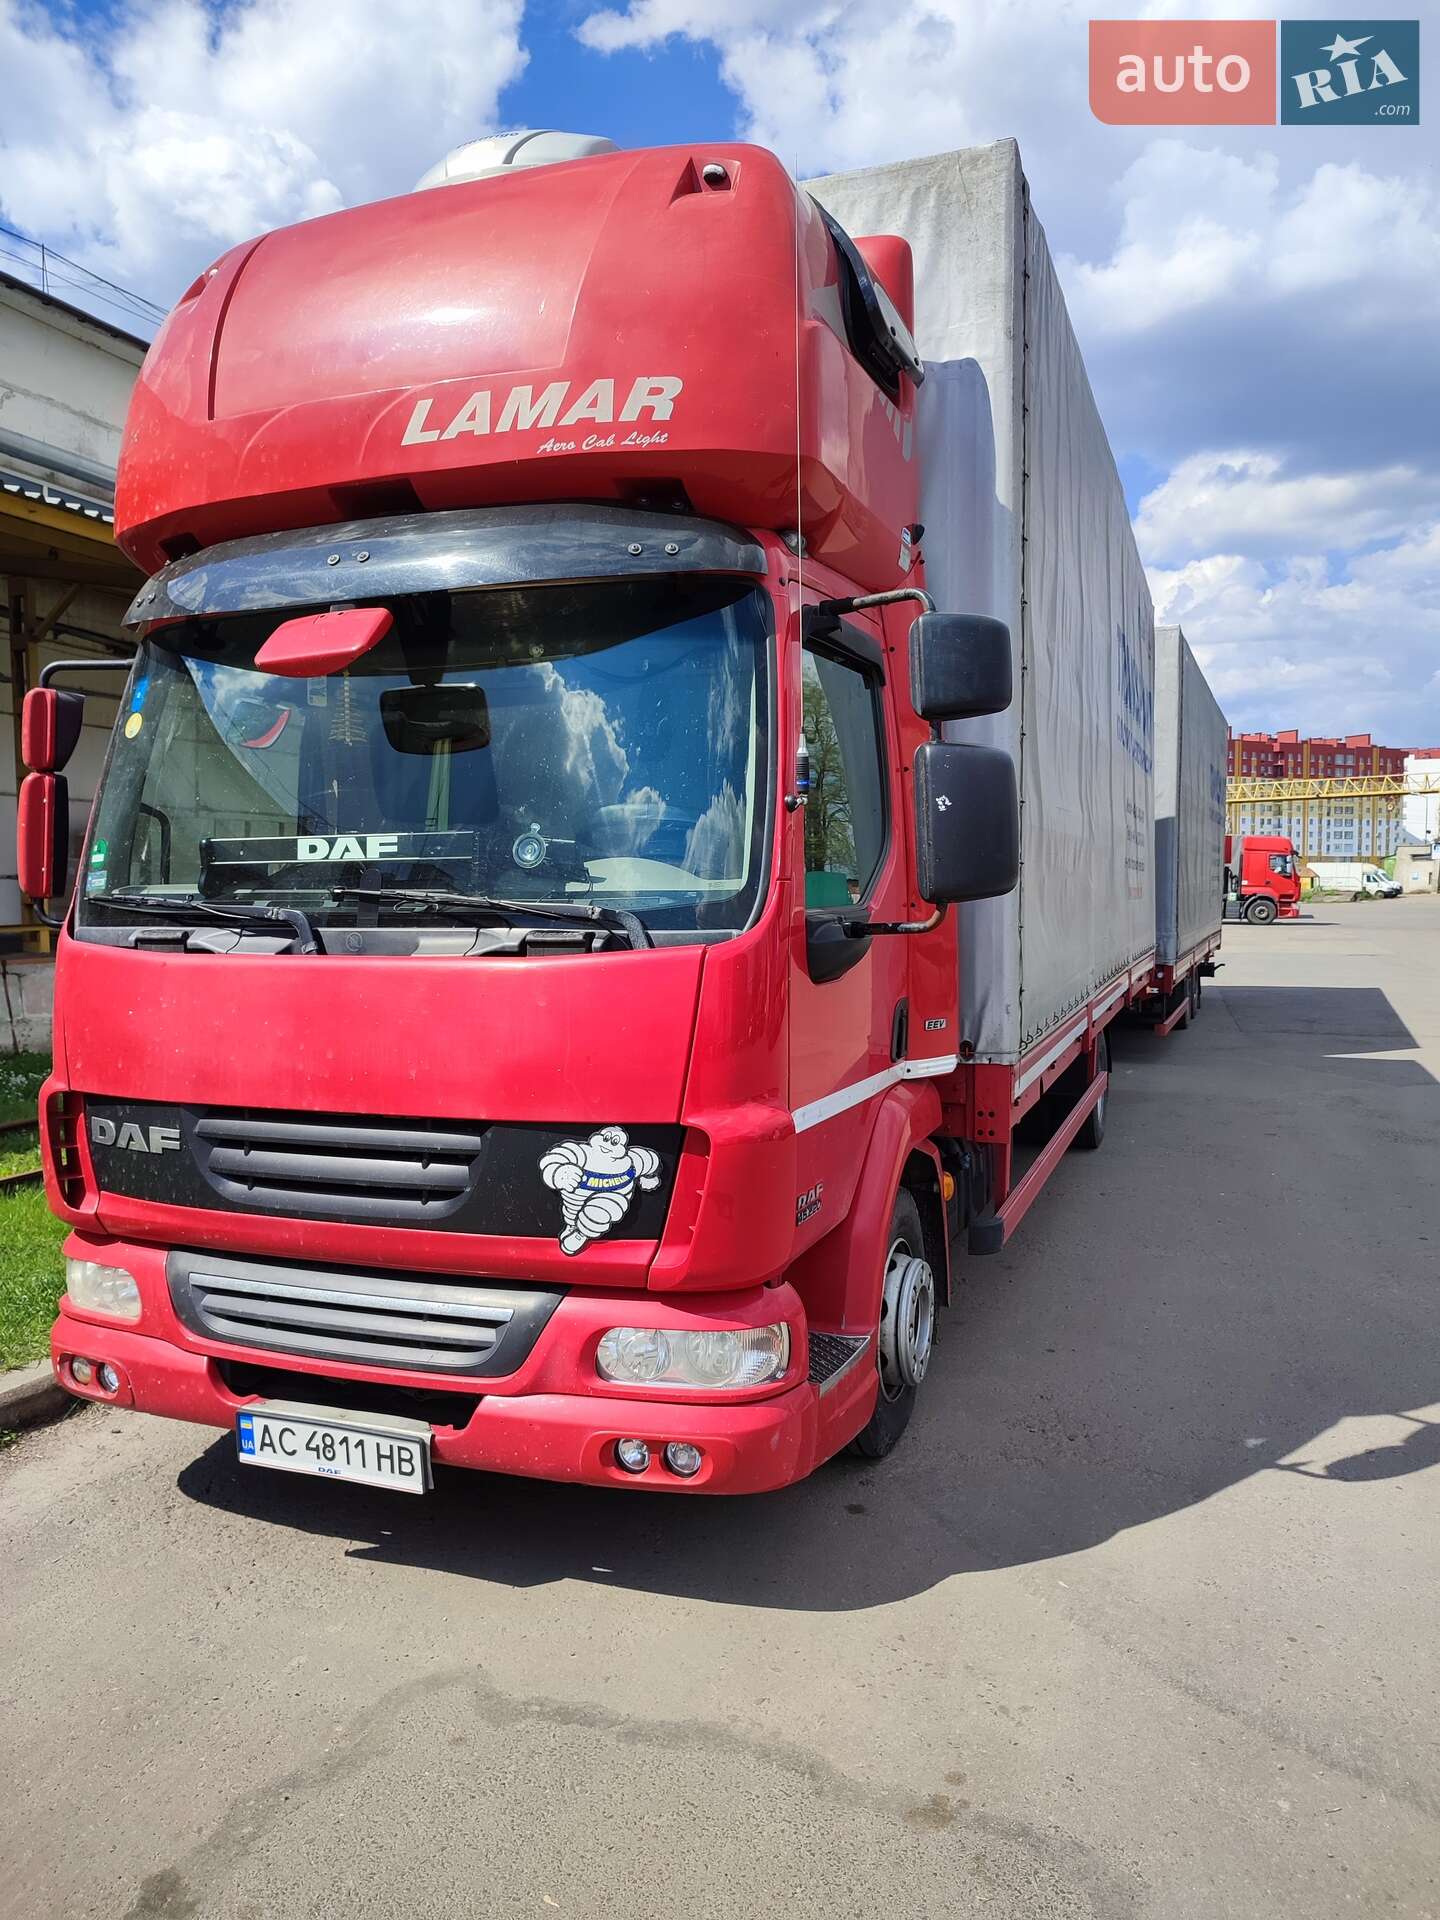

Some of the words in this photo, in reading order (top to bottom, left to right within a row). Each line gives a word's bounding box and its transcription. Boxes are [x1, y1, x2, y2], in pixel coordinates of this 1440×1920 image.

[400, 376, 684, 446] LAMAR
[537, 436, 577, 454] Aero
[582, 432, 616, 451] Cab
[621, 430, 669, 447] Light
[297, 836, 398, 860] DAF
[926, 1019, 945, 1030] EEV
[91, 1116, 180, 1154] DAF
[586, 1175, 631, 1188] MICHELIN
[797, 1183, 824, 1211] DAF
[242, 1439, 255, 1450] UA
[259, 1424, 298, 1457] AC
[305, 1430, 367, 1469] 4811
[375, 1441, 416, 1477] HB
